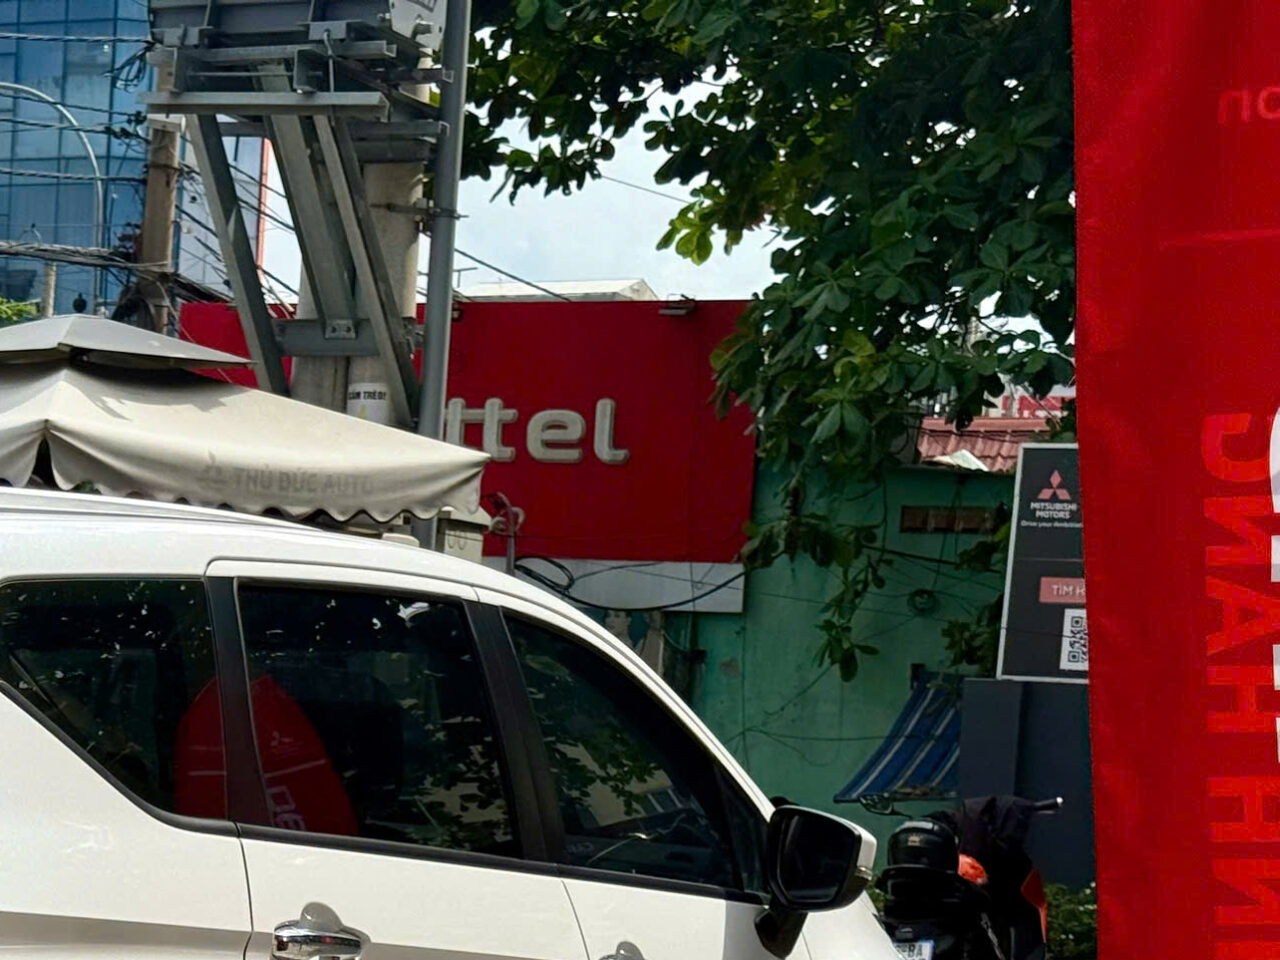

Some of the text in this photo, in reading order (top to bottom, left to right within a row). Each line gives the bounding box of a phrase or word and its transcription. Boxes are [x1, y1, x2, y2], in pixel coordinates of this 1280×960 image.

[443, 397, 630, 464] ttel
[323, 473, 373, 495] AUTO
[1030, 502, 1078, 511] MITSUBISHI
[1036, 510, 1070, 519] MOTORS
